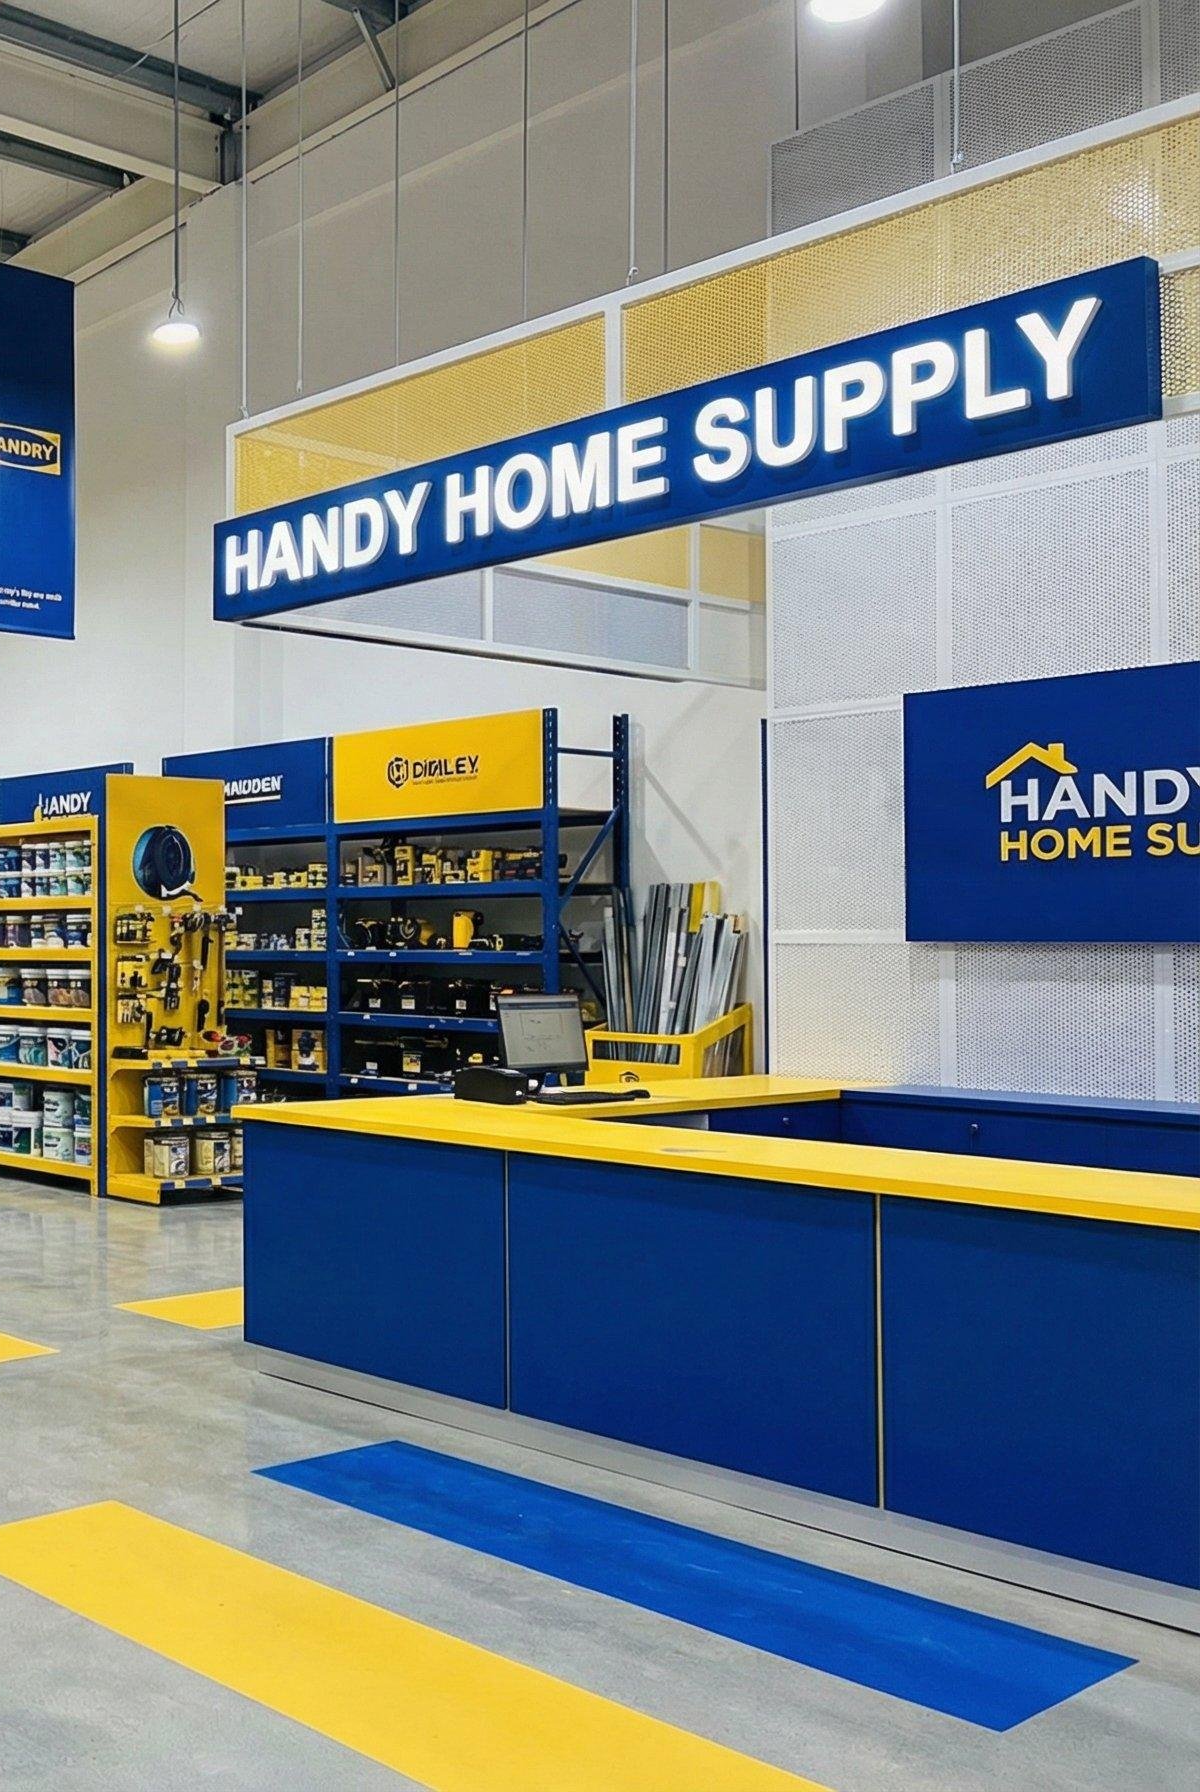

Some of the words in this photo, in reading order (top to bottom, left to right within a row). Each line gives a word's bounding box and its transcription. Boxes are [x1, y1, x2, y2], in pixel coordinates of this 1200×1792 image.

[224, 479, 432, 597] HANDY
[443, 415, 668, 544] HOME
[691, 294, 1102, 484] SUPPLY
[1000, 824, 1133, 862] HOME
